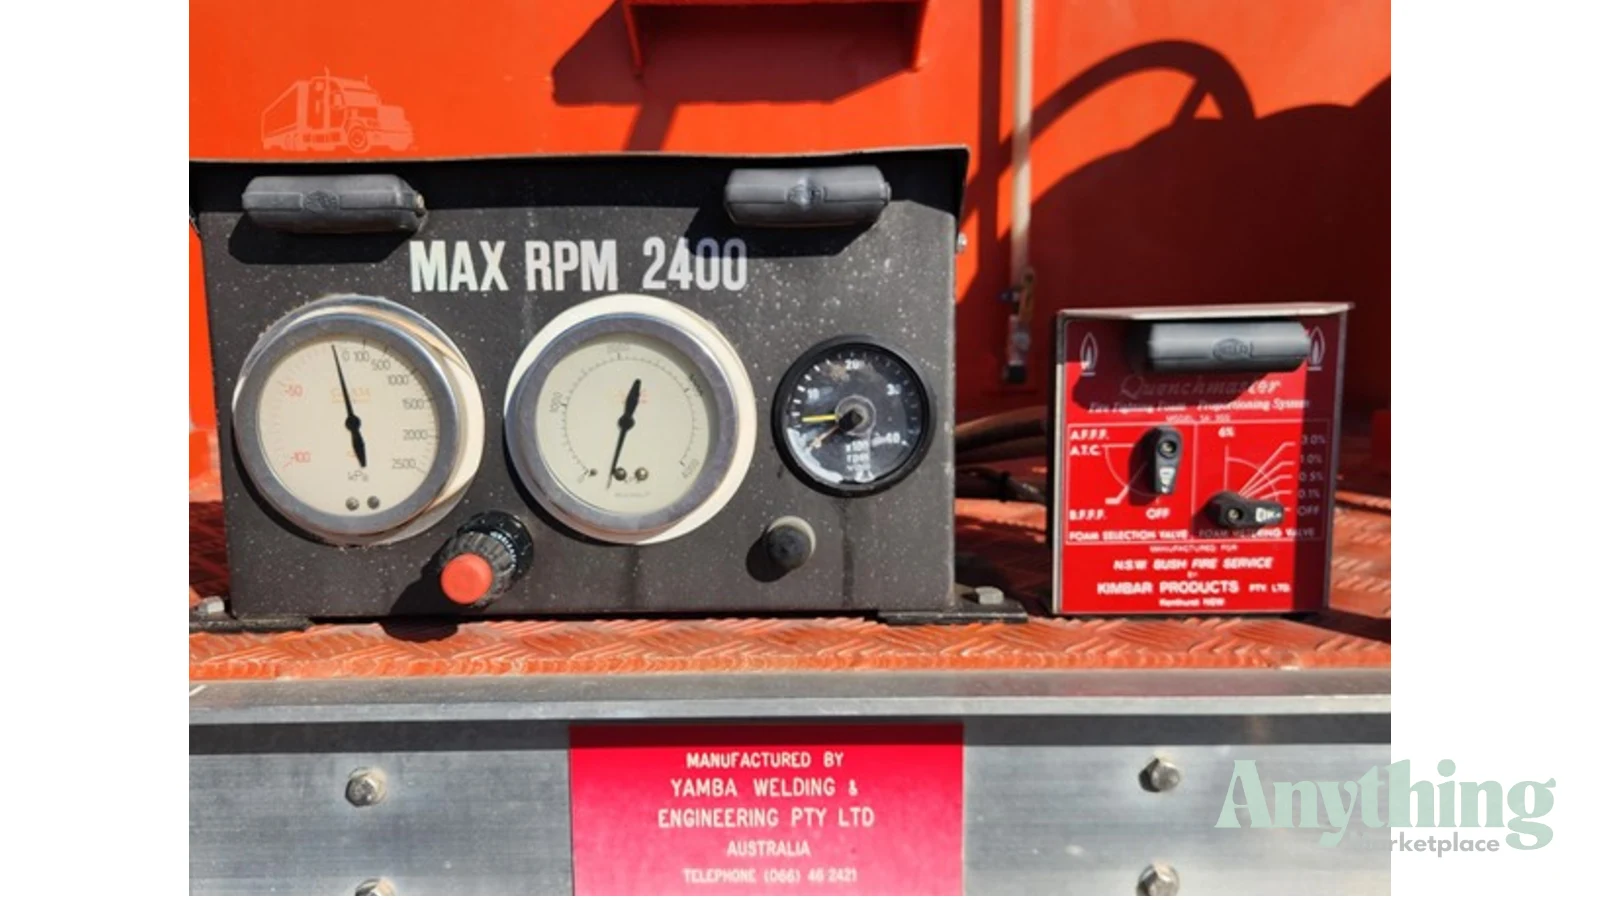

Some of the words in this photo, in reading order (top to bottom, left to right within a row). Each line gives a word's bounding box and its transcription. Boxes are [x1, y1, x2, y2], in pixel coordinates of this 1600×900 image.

[409, 240, 508, 292] MAX
[525, 240, 619, 291] RPM
[643, 236, 748, 291] 2400
[353, 350, 371, 363] 100
[370, 358, 392, 372] 500
[387, 374, 410, 386] 1000
[402, 398, 426, 410] 1500
[1196, 399, 1271, 412] Proportioning
[1272, 397, 1309, 411] System
[402, 429, 429, 442] 2000
[1217, 426, 1236, 439] 6%
[391, 458, 418, 471] 2500
[1146, 507, 1171, 520] OFF
[1297, 505, 1320, 516] OFF
[1069, 530, 1100, 541] FOAM
[1102, 530, 1157, 541] SELECTION
[1159, 529, 1189, 540] VALVE
[1198, 529, 1229, 539] FOAM
[1285, 527, 1316, 538] VALVE
[1153, 558, 1188, 571] BUSH
[1191, 557, 1218, 570] FIRE
[1222, 556, 1275, 570] SERVICE
[1096, 582, 1153, 596] KIMBAR
[1159, 580, 1241, 595] PRODUCTS
[686, 751, 812, 769] MANUFACTURED
[823, 751, 844, 767] BY
[671, 778, 739, 798] YAMBA
[753, 777, 836, 797] WELDING
[847, 778, 859, 797] &
[657, 807, 780, 829] ENGINEERING
[790, 807, 827, 829] PTY
[837, 806, 876, 828] LTD
[726, 840, 812, 858] AUSTRALIA
[682, 868, 757, 884] TELEPHONE
[763, 868, 802, 884] (066)
